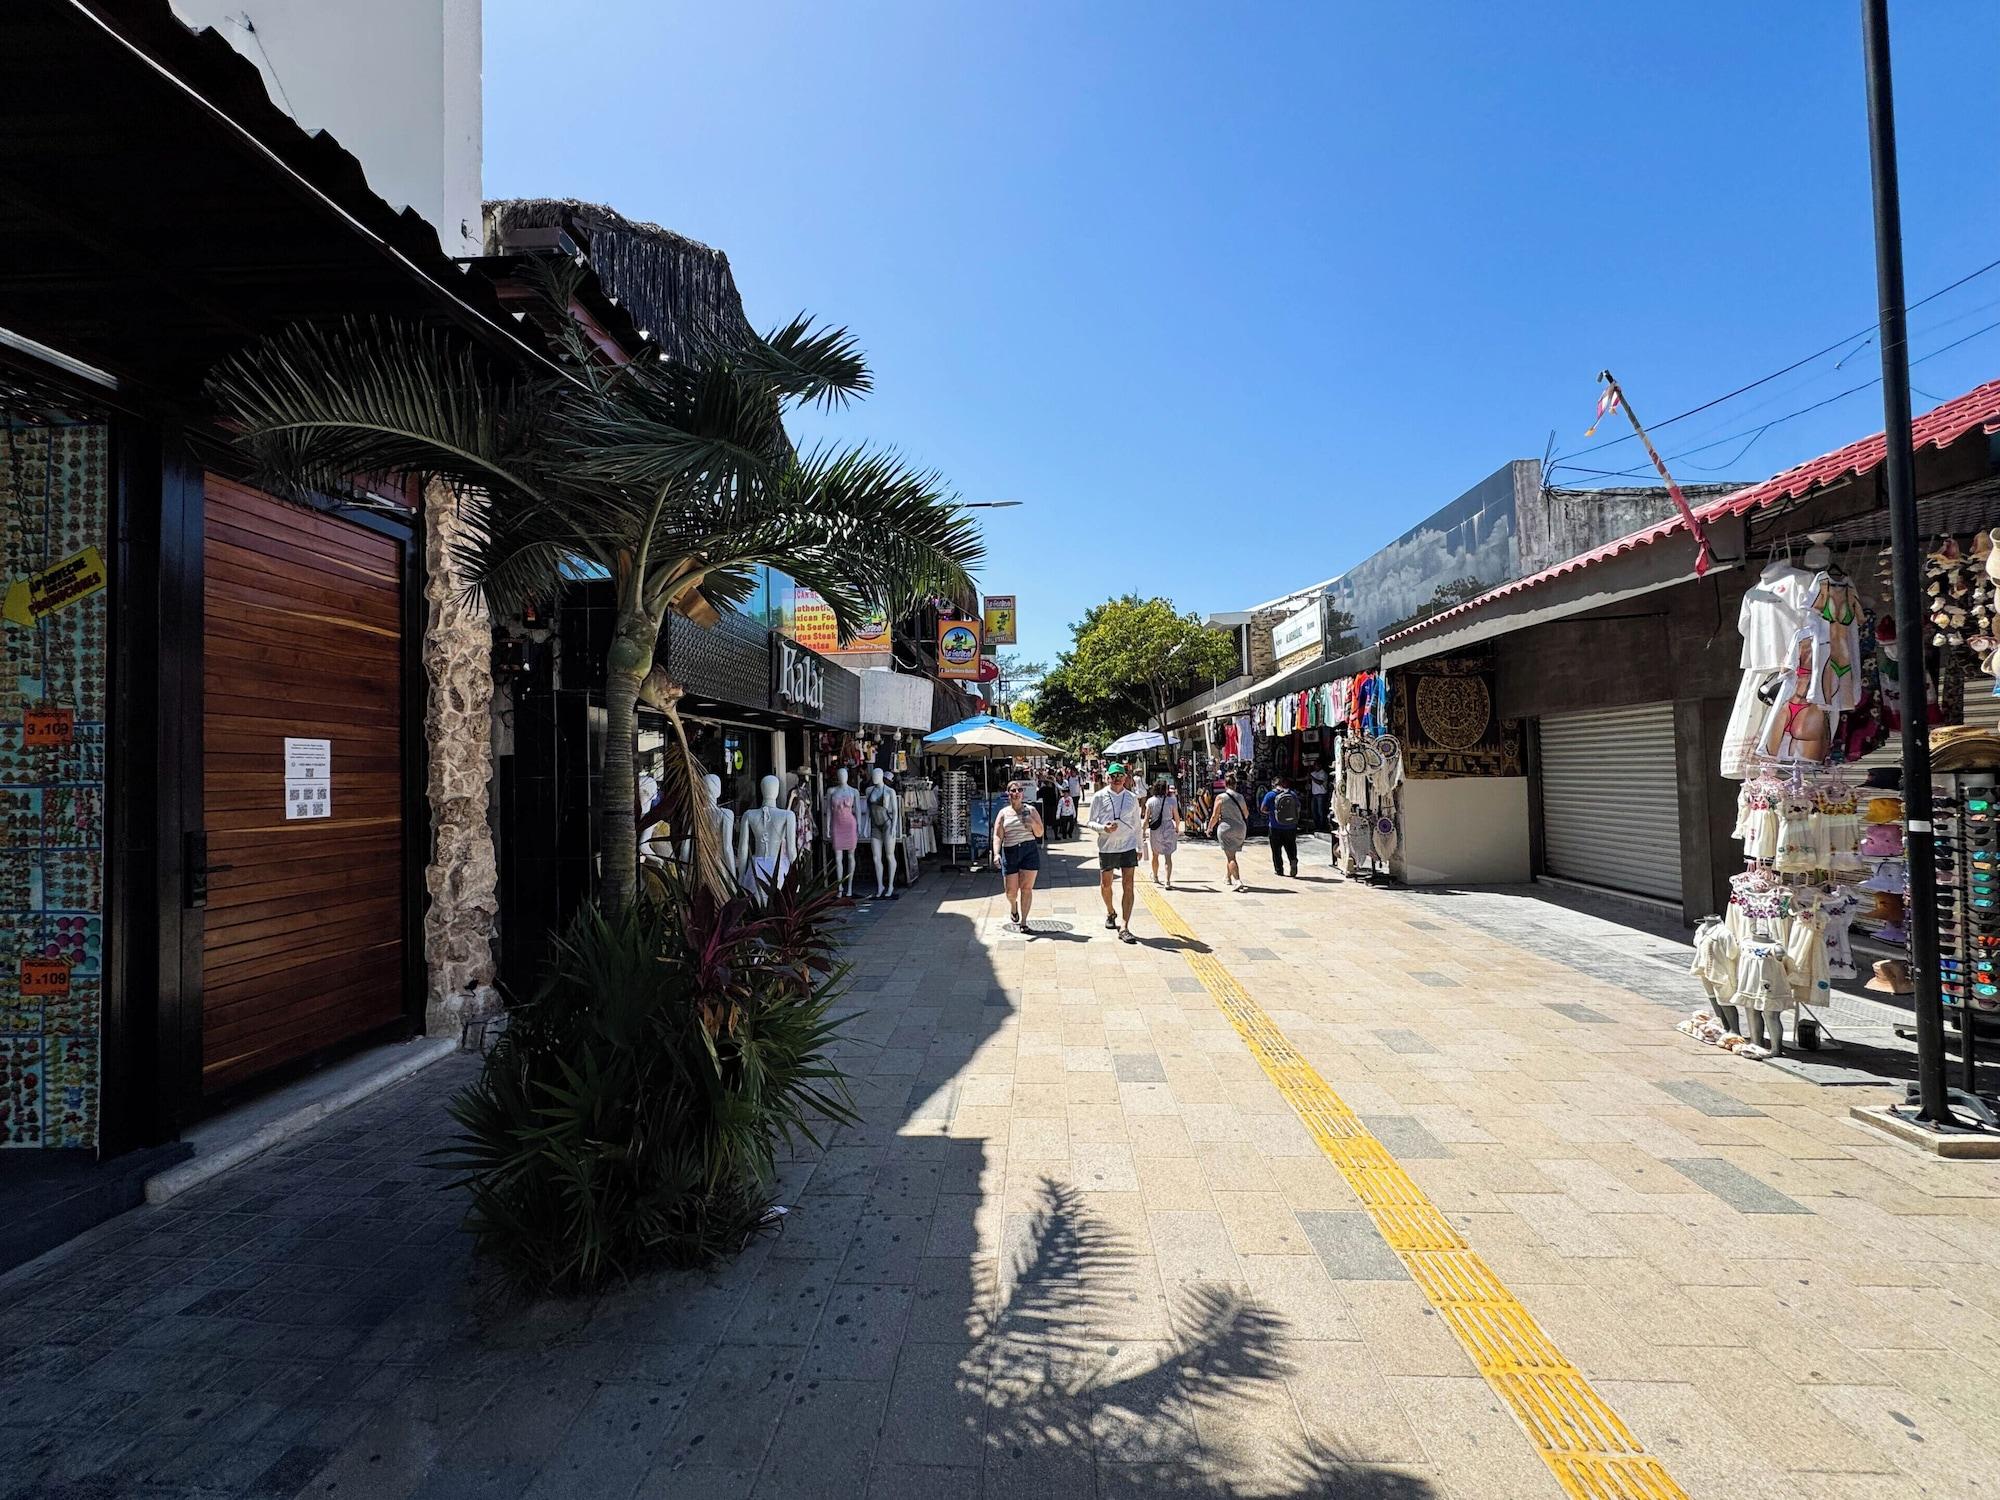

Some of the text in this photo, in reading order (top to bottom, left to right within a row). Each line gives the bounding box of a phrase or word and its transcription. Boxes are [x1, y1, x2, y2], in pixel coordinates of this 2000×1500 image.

[813, 632, 837, 641] Steak
[27, 723, 35, 736] 3
[23, 973, 32, 985] 3
[41, 973, 67, 985] 109
